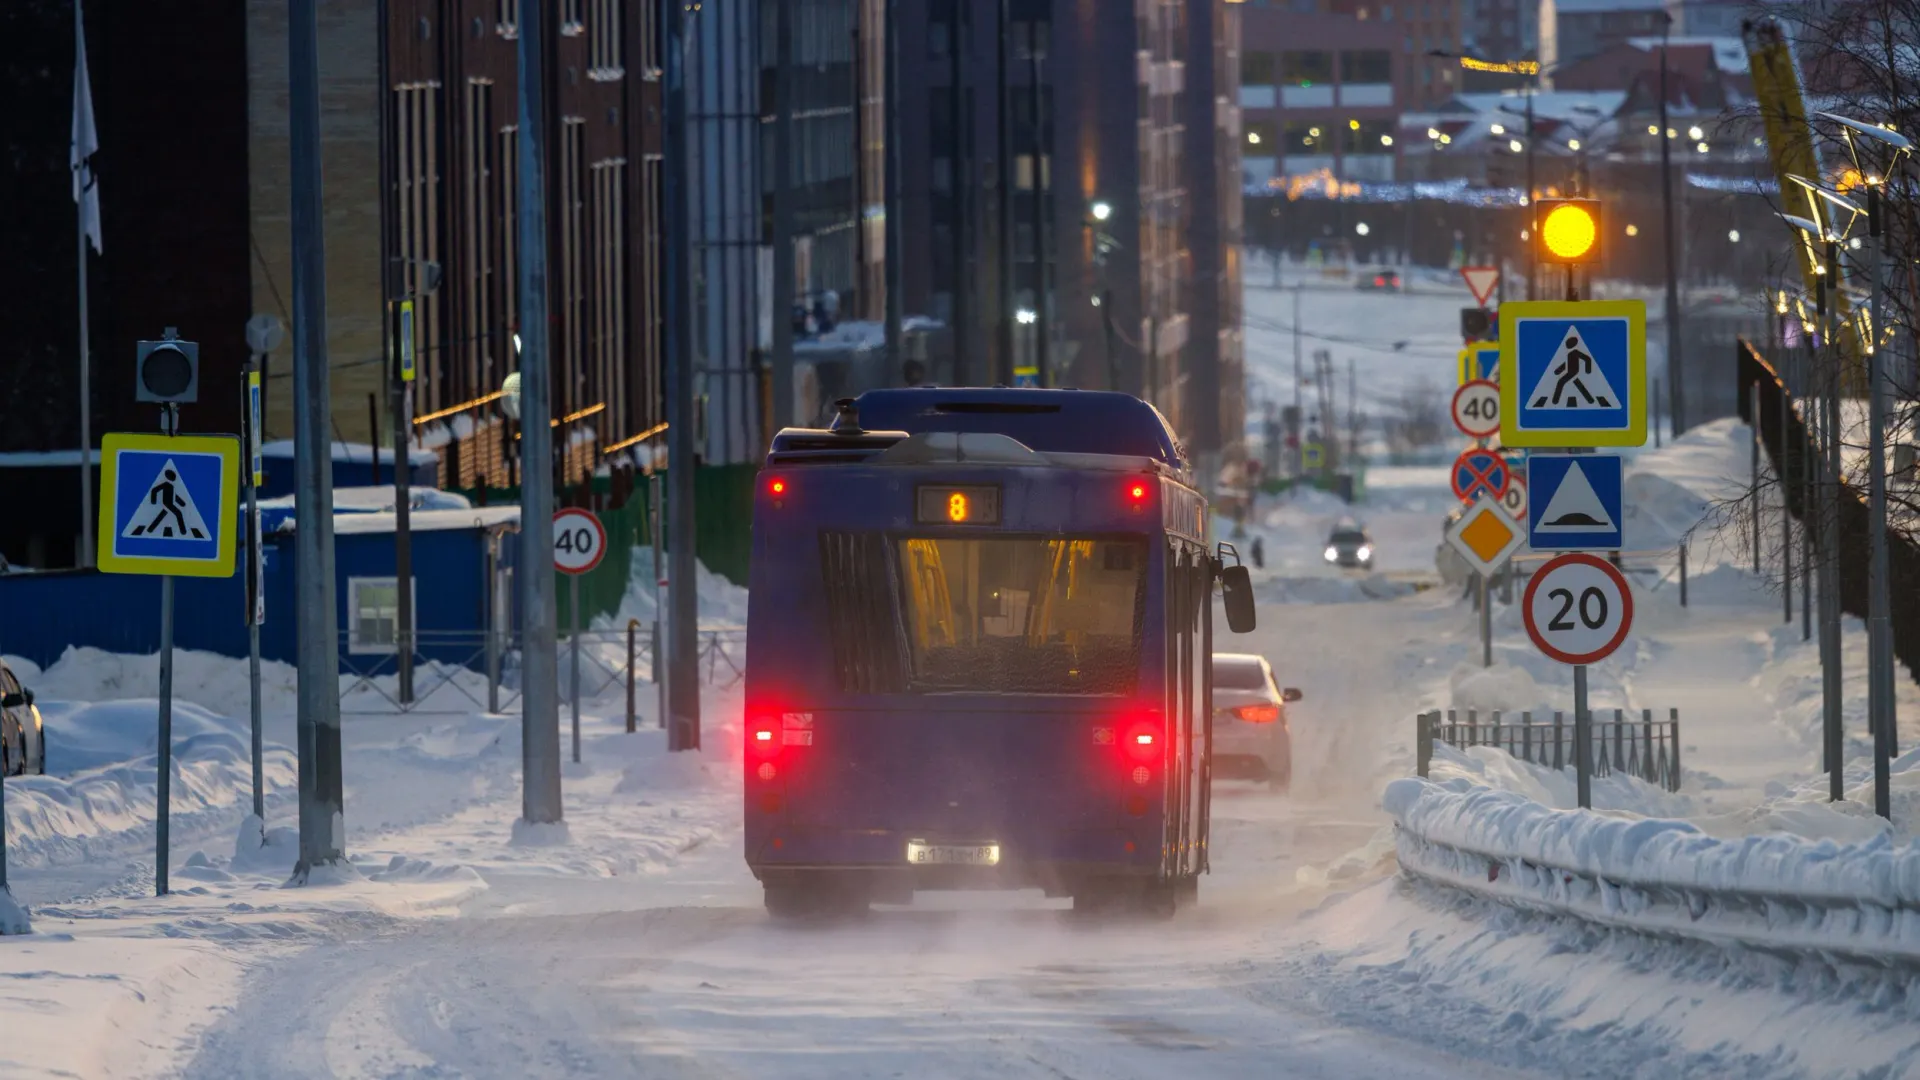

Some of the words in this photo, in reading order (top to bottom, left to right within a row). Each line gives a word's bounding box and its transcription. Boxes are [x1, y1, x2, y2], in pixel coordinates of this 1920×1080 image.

[1463, 397, 1498, 420] 40
[950, 493, 965, 521] 8
[555, 528, 592, 554] 40
[1548, 586, 1608, 631] 20
